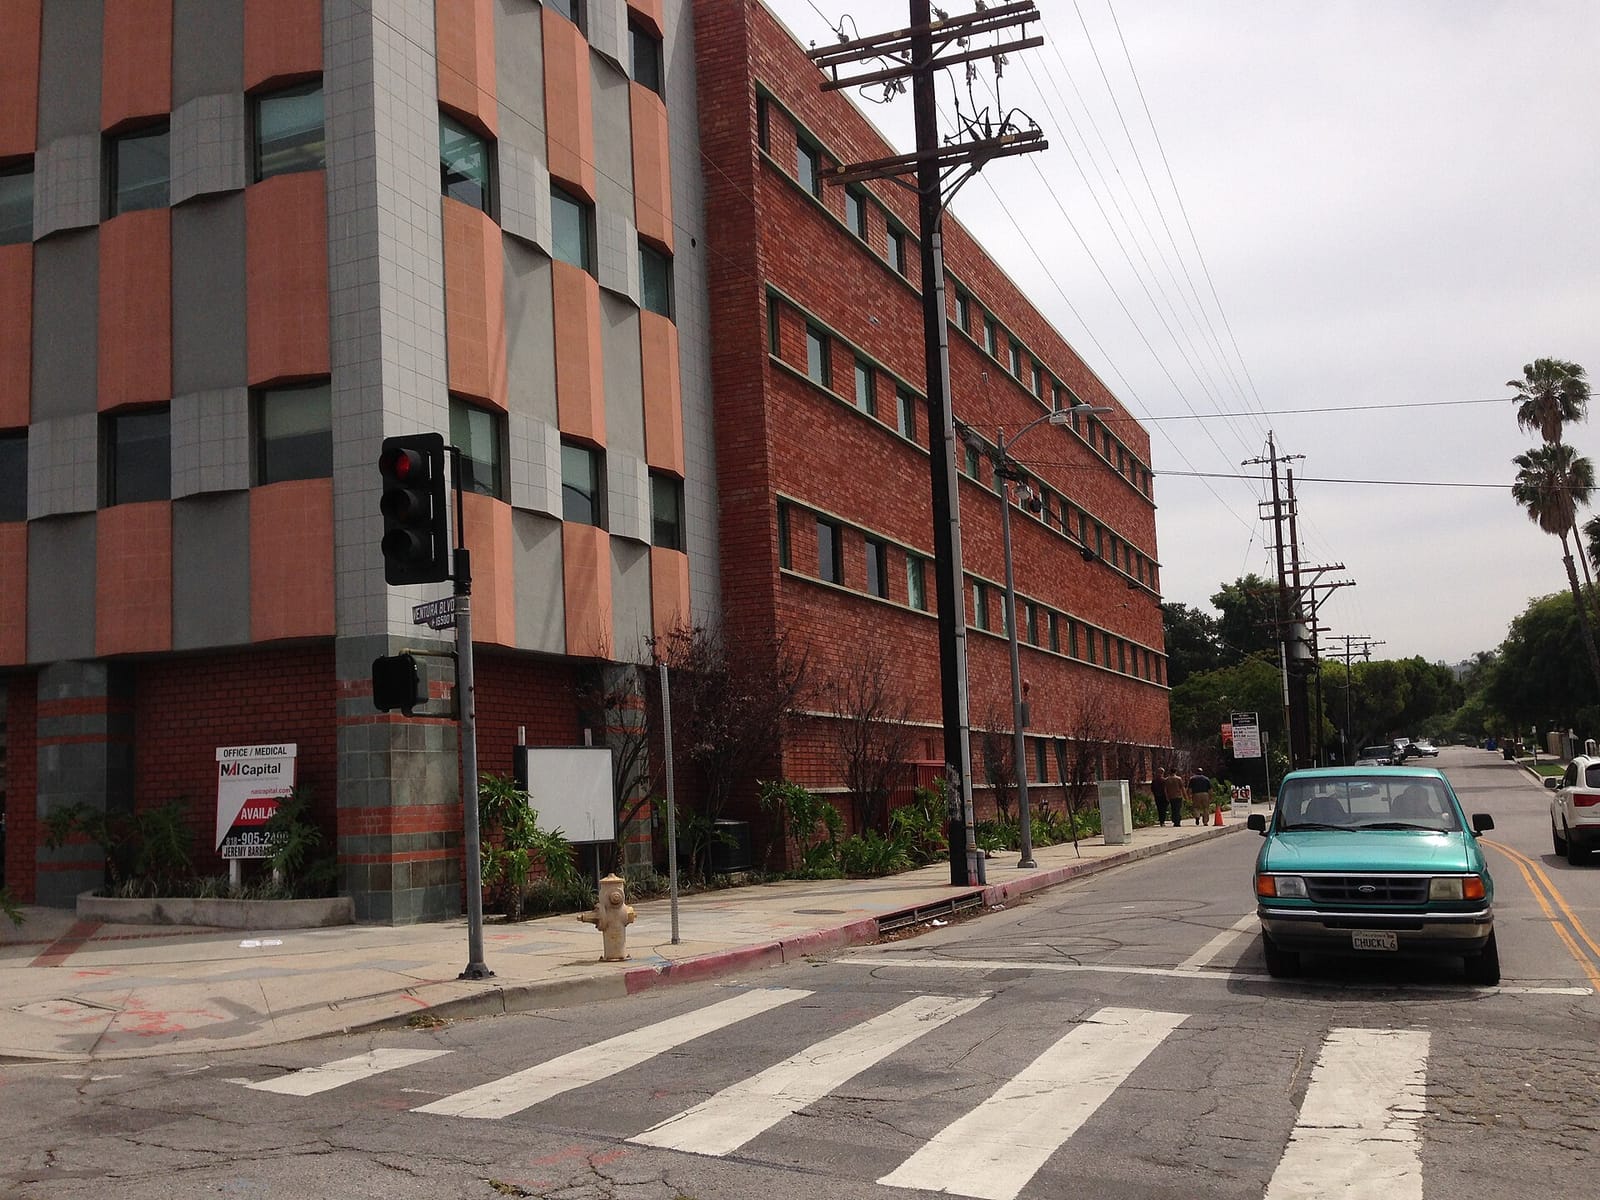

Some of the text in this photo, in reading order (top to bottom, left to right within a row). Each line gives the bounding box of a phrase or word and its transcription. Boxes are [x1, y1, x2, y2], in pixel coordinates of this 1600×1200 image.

[439, 599, 454, 614] BLVD
[223, 748, 248, 758] OFFICE
[254, 746, 287, 756] MEDICAL
[241, 762, 281, 776] Capital
[223, 845, 246, 858] JEREMY
